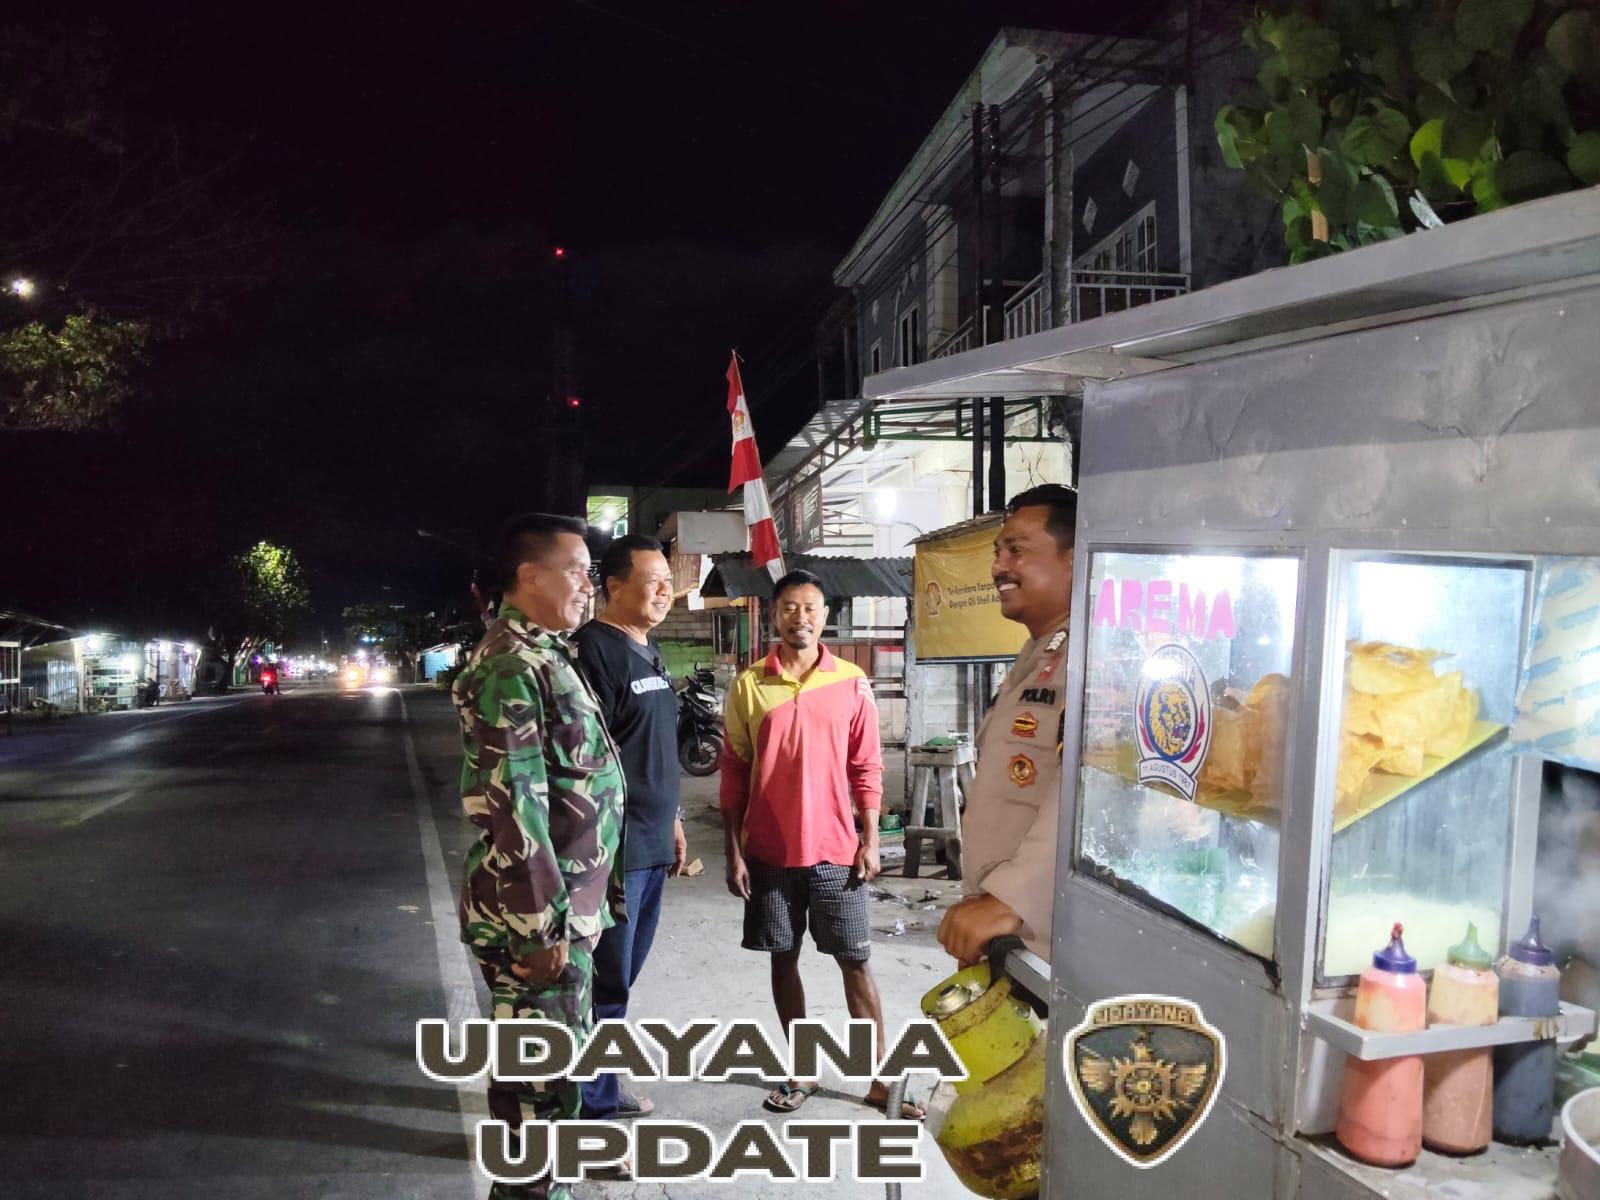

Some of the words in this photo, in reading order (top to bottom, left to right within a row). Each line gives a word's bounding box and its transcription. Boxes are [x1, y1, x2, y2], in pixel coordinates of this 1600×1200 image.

[1094, 579, 1236, 639] AREMA
[1019, 688, 1056, 705] POLRI
[1150, 763, 1177, 778] AGUSTUS
